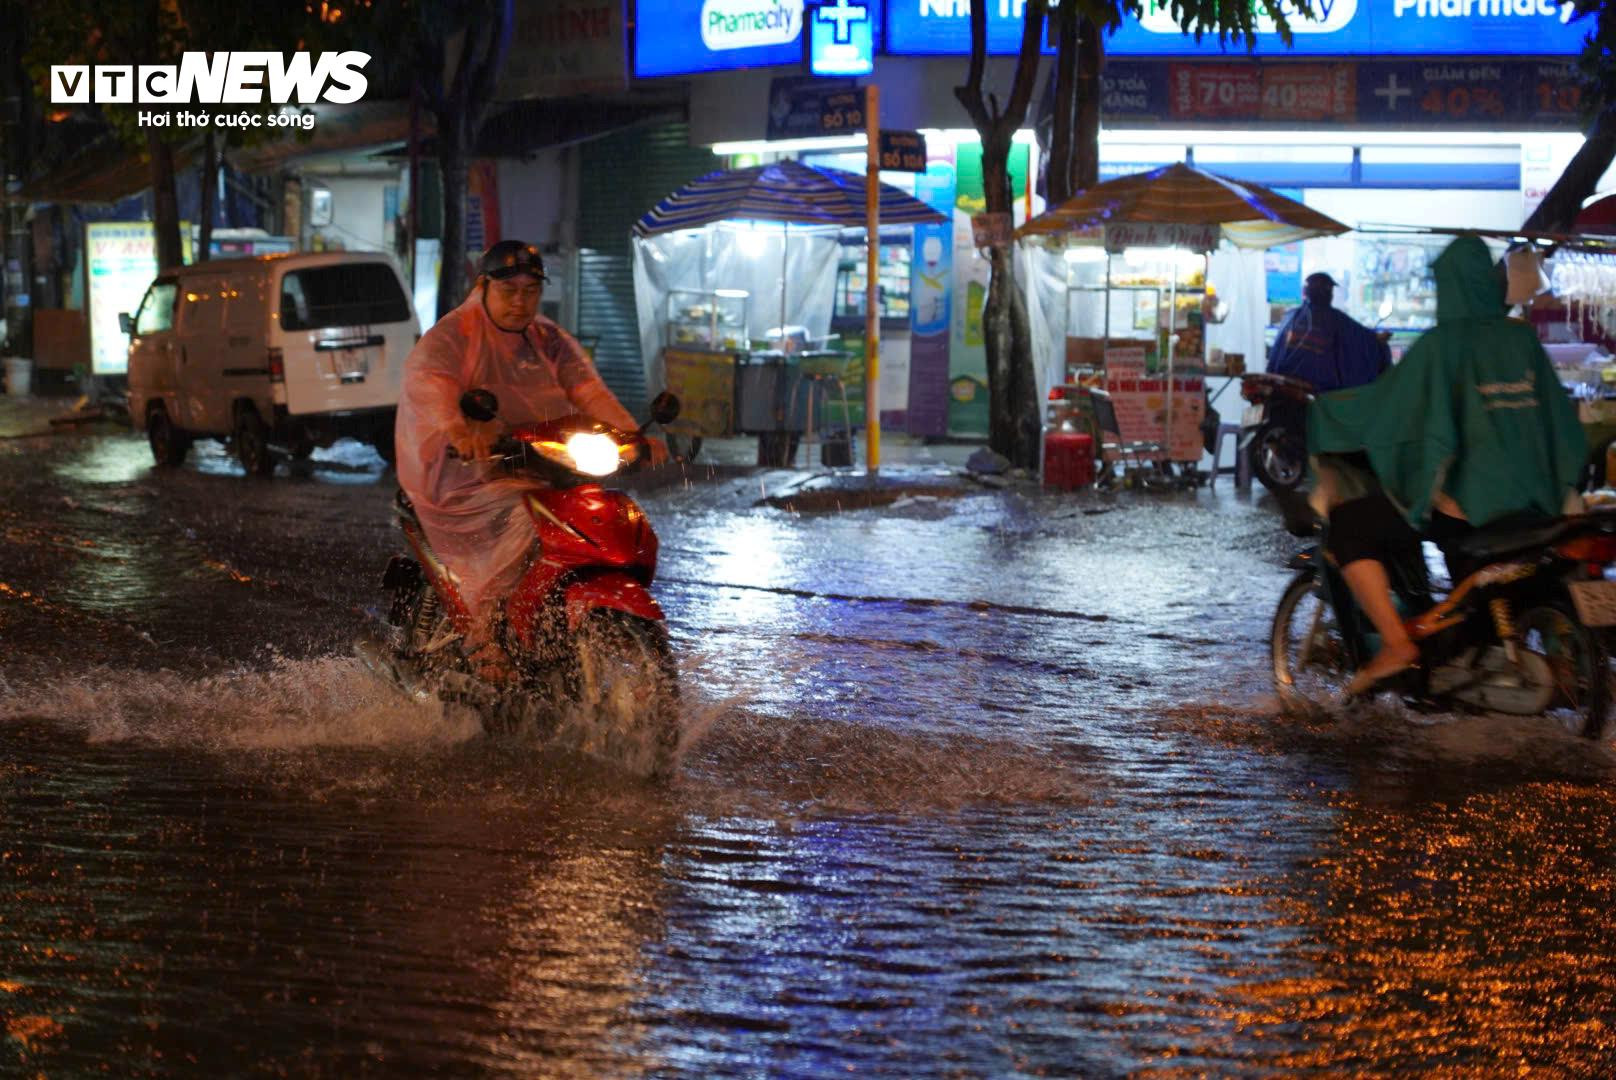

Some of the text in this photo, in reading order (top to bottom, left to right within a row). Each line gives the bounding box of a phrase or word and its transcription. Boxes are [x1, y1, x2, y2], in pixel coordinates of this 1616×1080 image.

[708, 5, 794, 34] Pharmacity
[1199, 81, 1235, 105] 70
[1263, 84, 1297, 107] 40
[823, 108, 843, 128] SỐ
[847, 110, 861, 126] 10
[884, 150, 900, 168] SỐ
